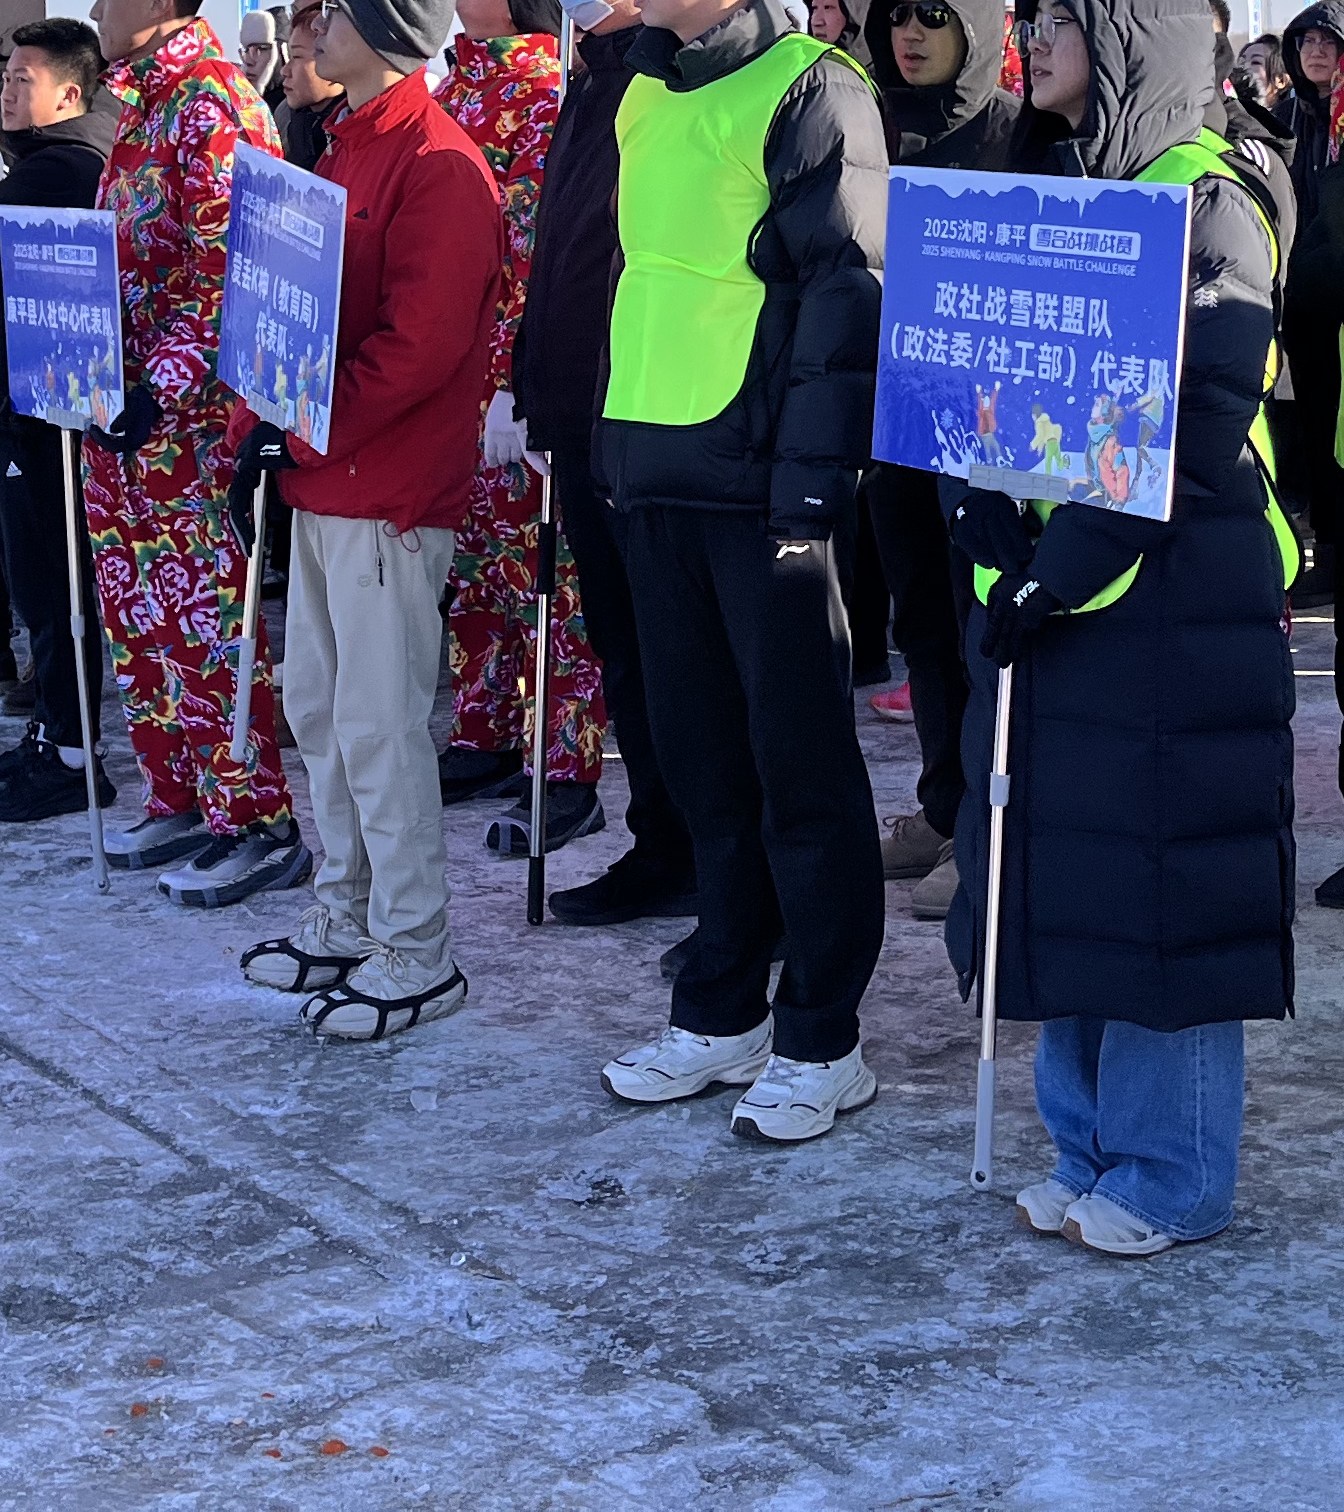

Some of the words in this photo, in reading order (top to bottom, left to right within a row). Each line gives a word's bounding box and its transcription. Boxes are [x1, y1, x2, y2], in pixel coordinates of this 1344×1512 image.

[923, 217, 1026, 248] 2025沈阳·康平
[921, 244, 940, 257] 2025
[1027, 254, 1051, 268] SNOW
[1053, 257, 1084, 272] BATTLE
[1085, 259, 1136, 277] CHALLENGE
[6, 296, 114, 337] 康平县人社中心代表队
[934, 281, 1113, 339] 政社战雪联盟队
[255, 310, 289, 361] 代表队
